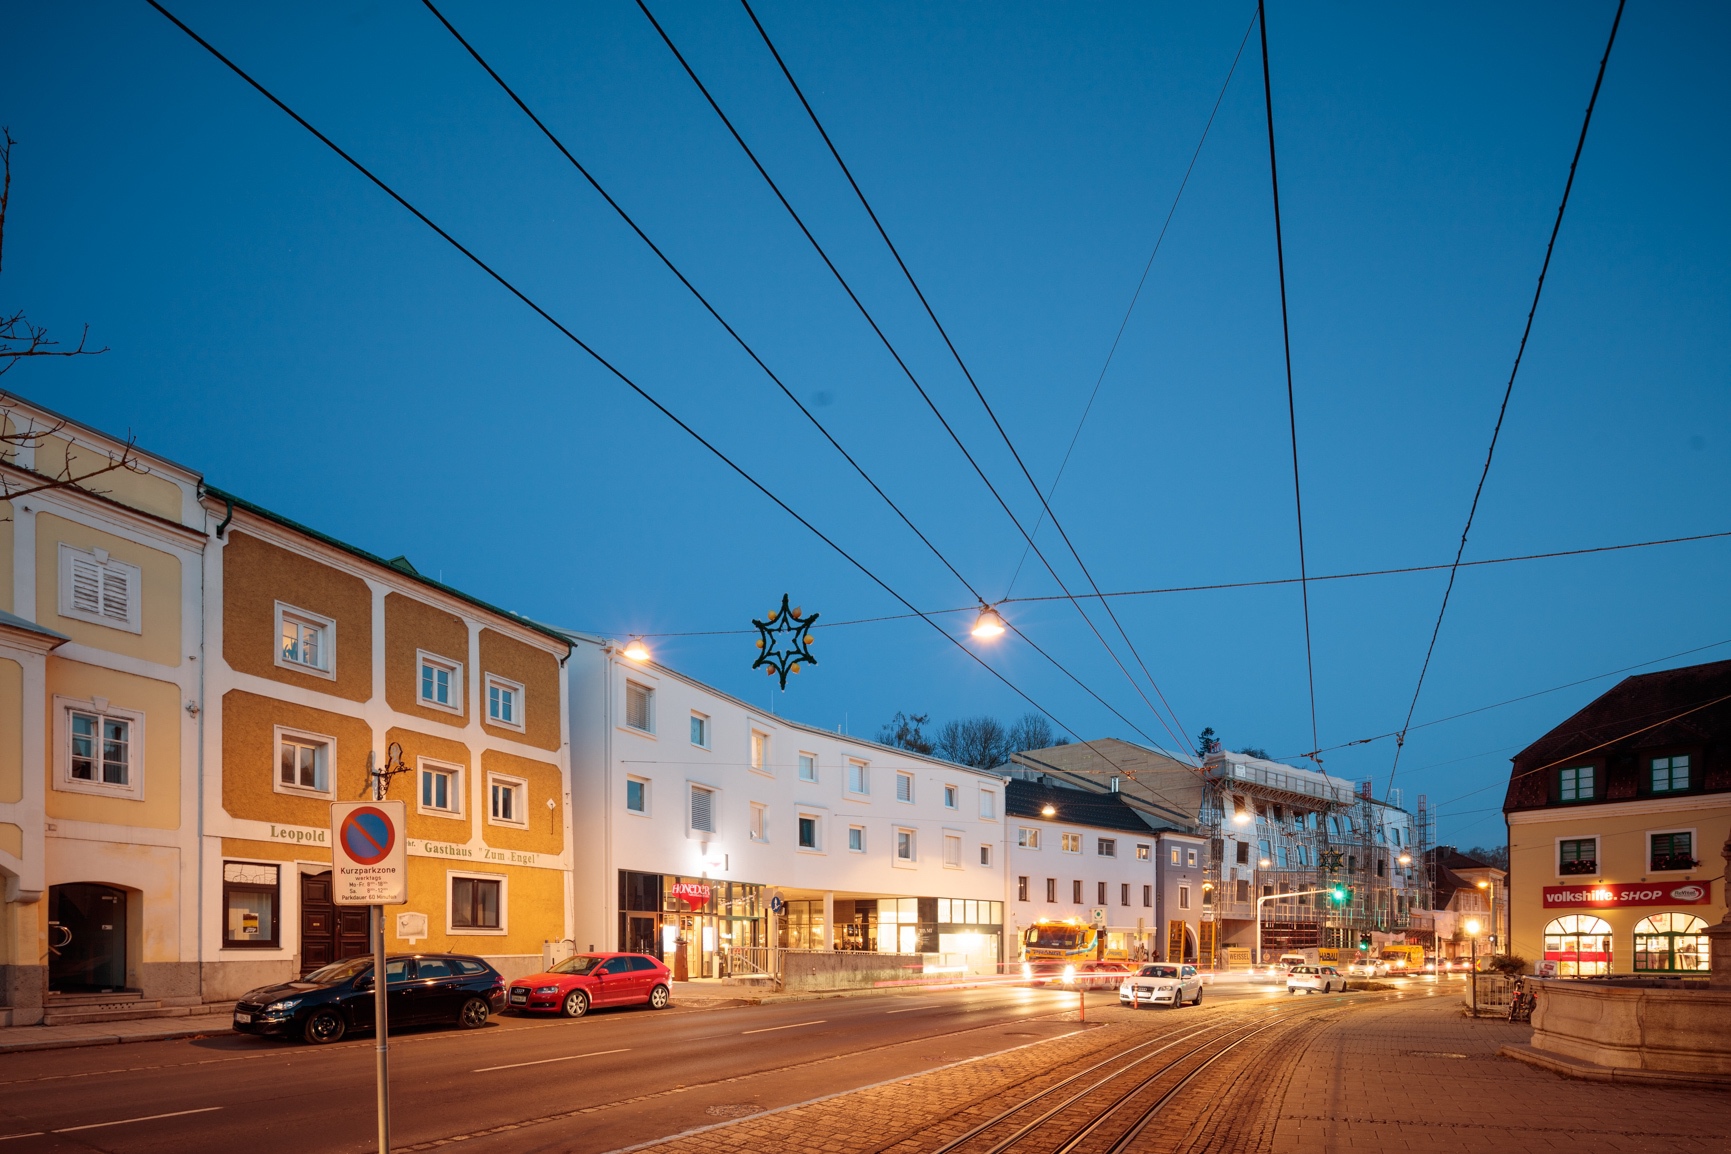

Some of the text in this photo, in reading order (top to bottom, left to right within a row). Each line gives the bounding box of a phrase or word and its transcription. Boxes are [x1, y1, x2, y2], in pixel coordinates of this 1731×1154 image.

[270, 825, 325, 843] Leopold
[424, 841, 472, 857] Gasthaus
[340, 867, 396, 875] Kurzparkzone
[1620, 890, 1662, 900] SHOP
[1229, 952, 1250, 961] WEISSEL
